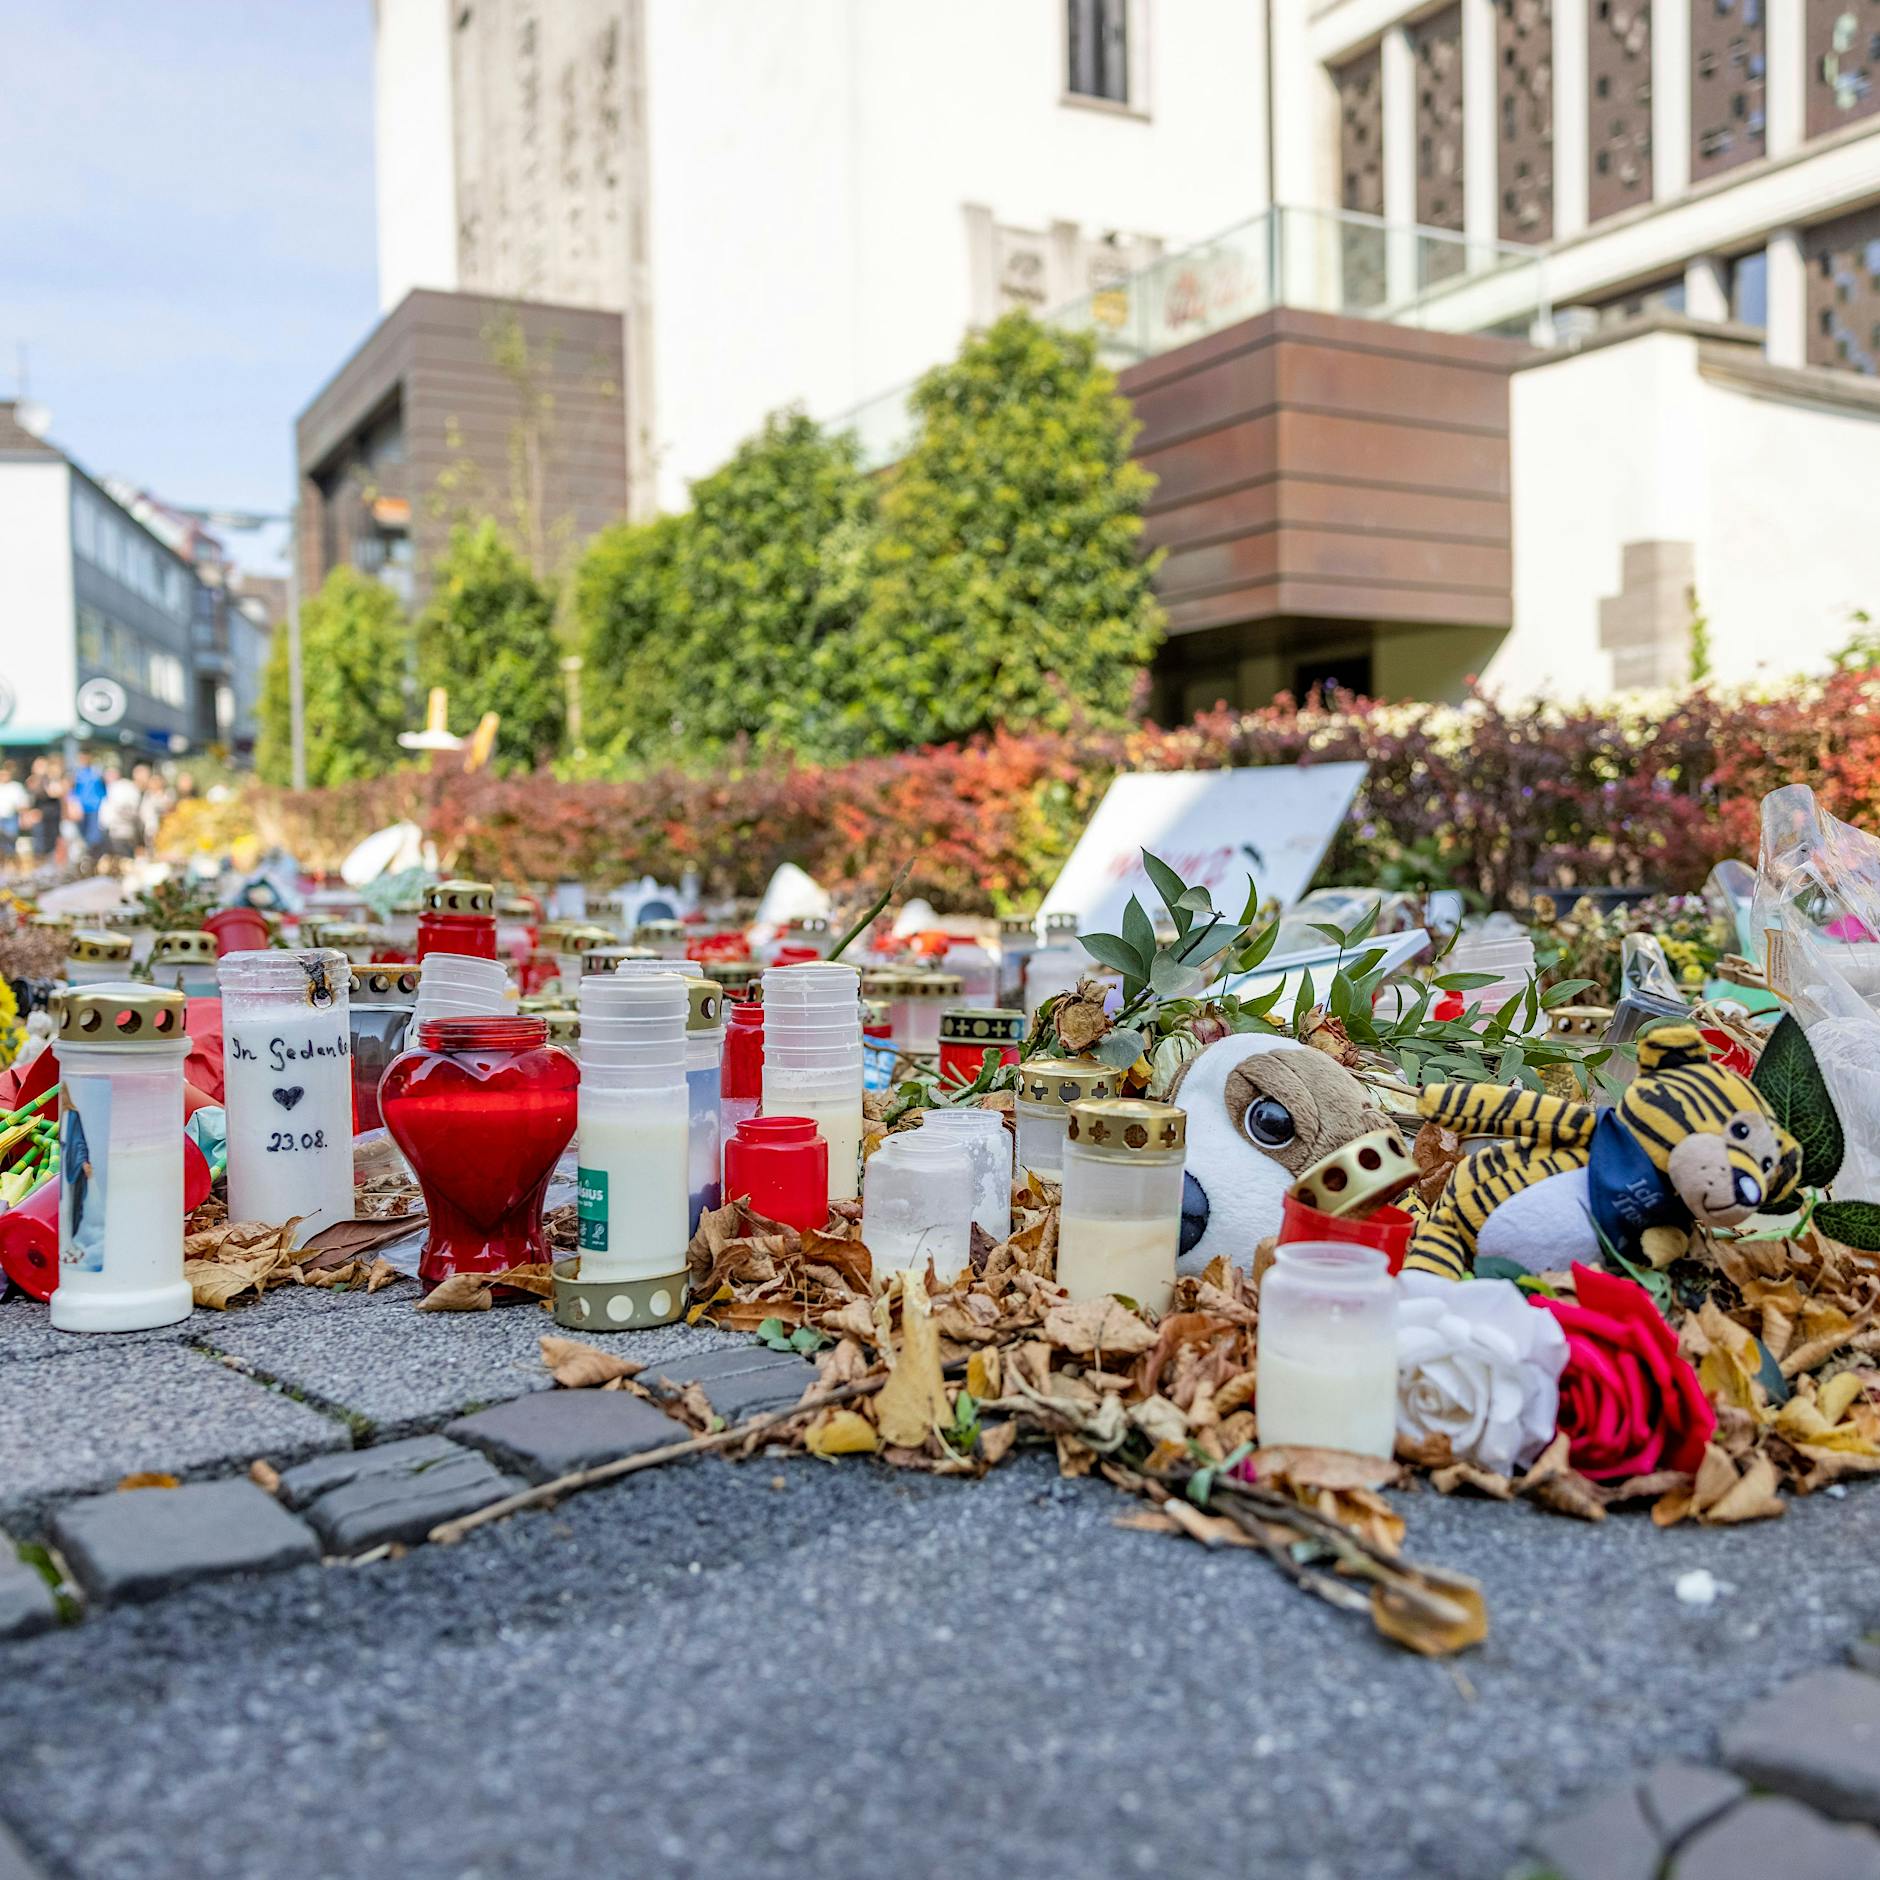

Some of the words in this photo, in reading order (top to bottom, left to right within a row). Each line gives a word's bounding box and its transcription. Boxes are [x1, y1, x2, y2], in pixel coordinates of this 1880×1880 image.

[232, 1037, 258, 1060] In
[266, 1129, 328, 1153] 23.08.
[1625, 1178, 1664, 1208] Ich
